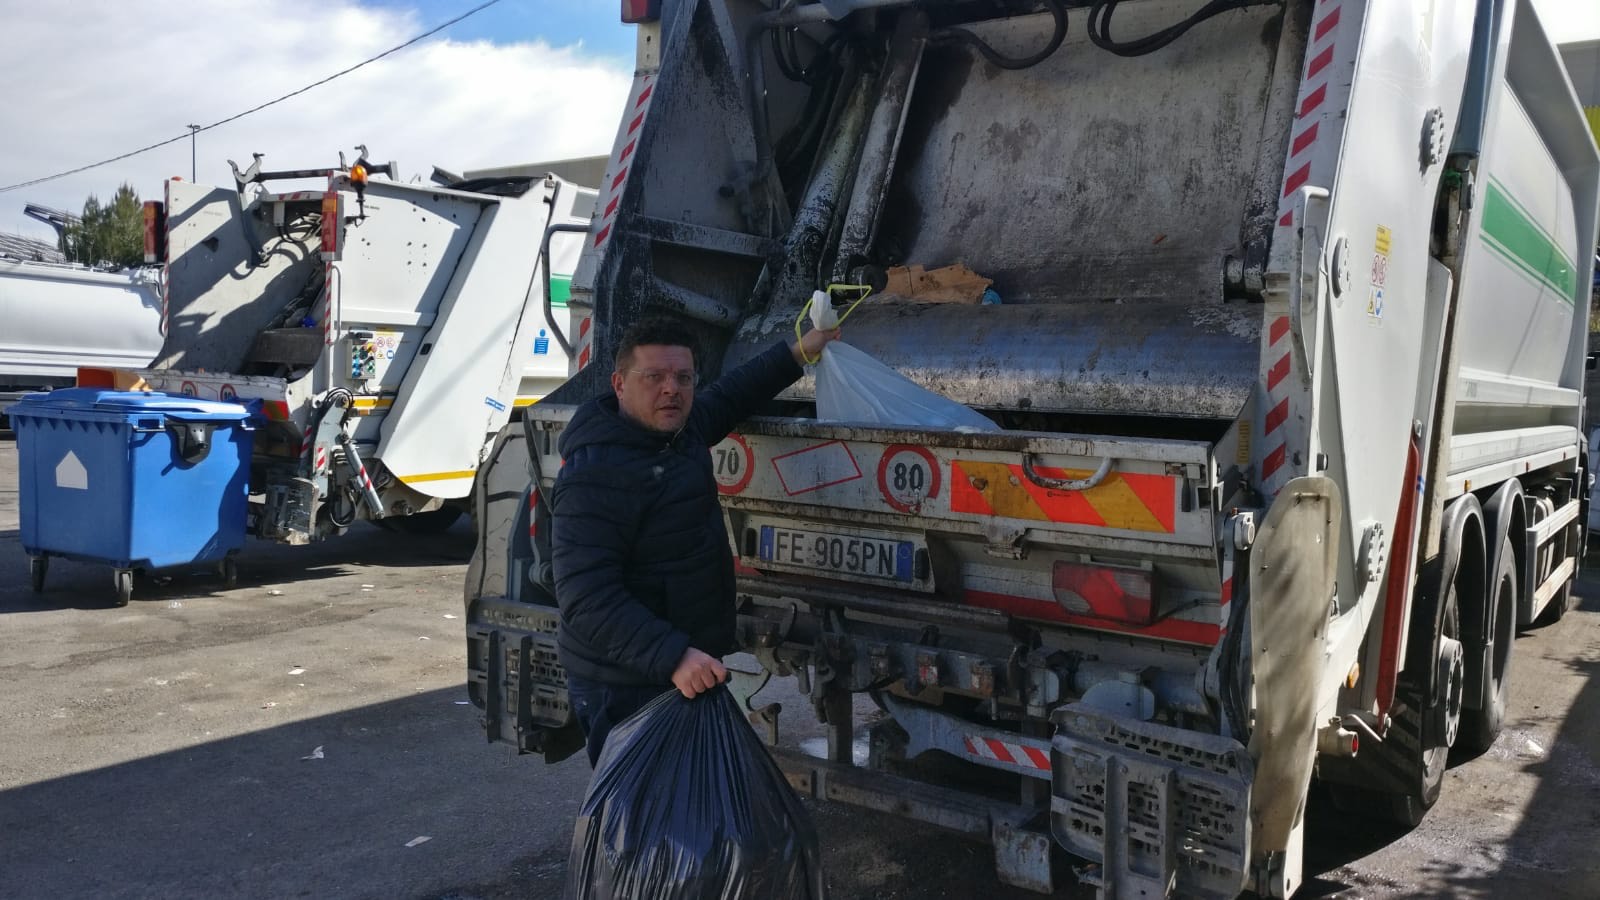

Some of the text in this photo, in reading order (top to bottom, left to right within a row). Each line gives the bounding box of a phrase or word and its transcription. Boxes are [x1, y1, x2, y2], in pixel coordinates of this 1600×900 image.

[716, 447, 740, 475] 70
[894, 462, 924, 492] 80
[776, 532, 893, 576] FE 905PN
